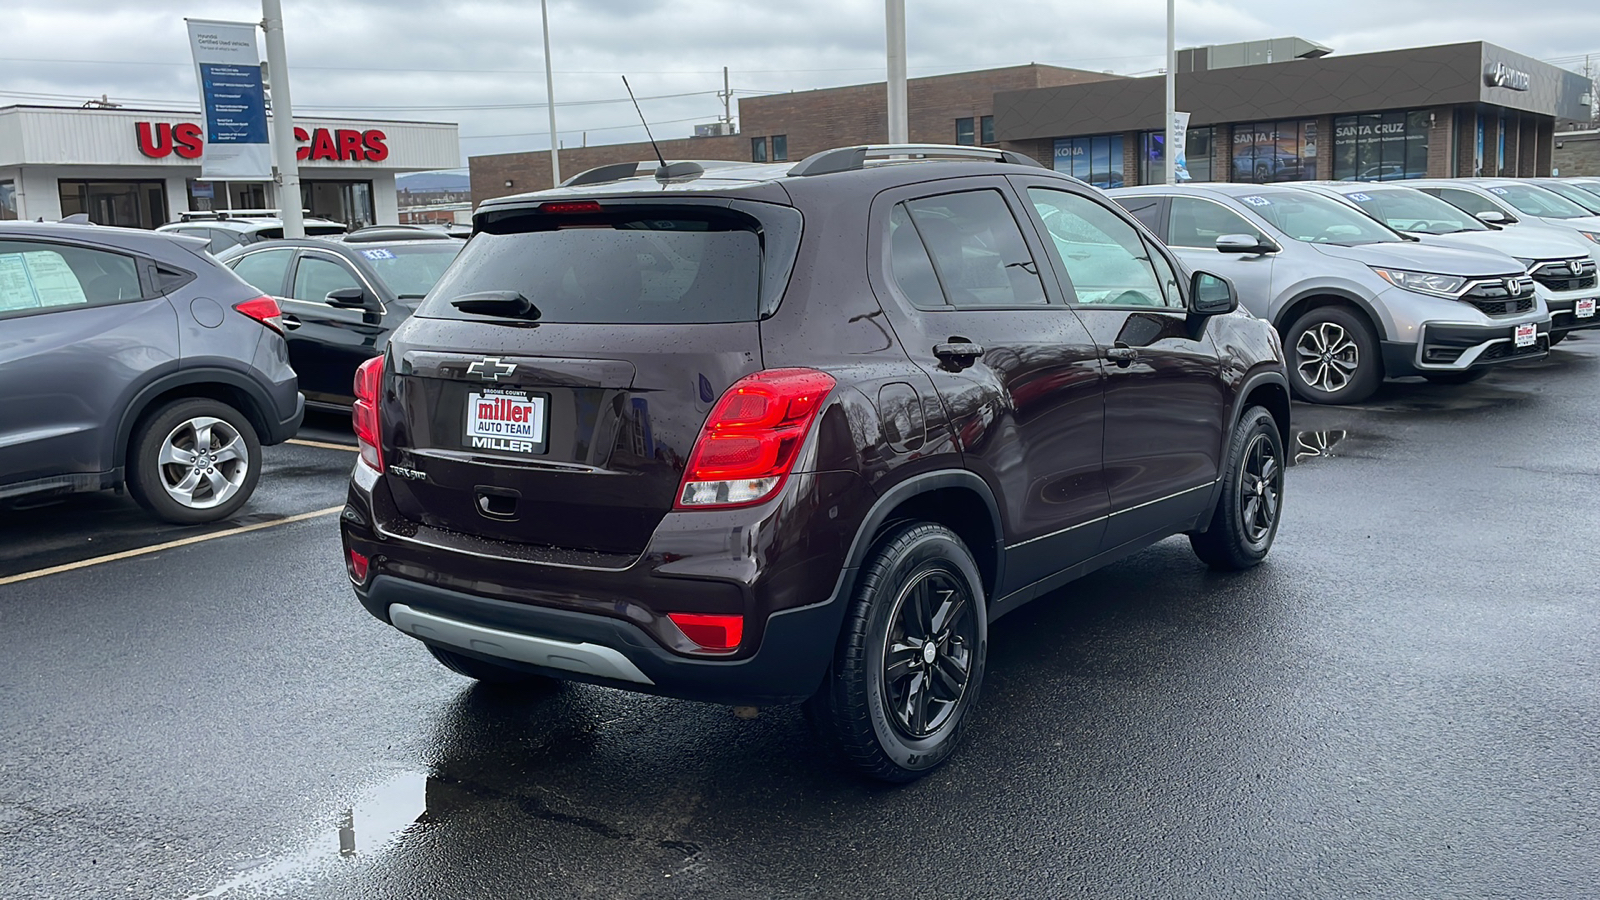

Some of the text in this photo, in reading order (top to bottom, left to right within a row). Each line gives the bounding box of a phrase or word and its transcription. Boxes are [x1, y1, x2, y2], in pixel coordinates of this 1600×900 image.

[1335, 123, 1404, 137] SANTA CRUZ
[1233, 132, 1267, 144] SANTA
[1054, 146, 1084, 157] KONA
[478, 397, 532, 423] miller
[478, 421, 531, 435] AUTO TEAM
[472, 437, 533, 453] MILLER
